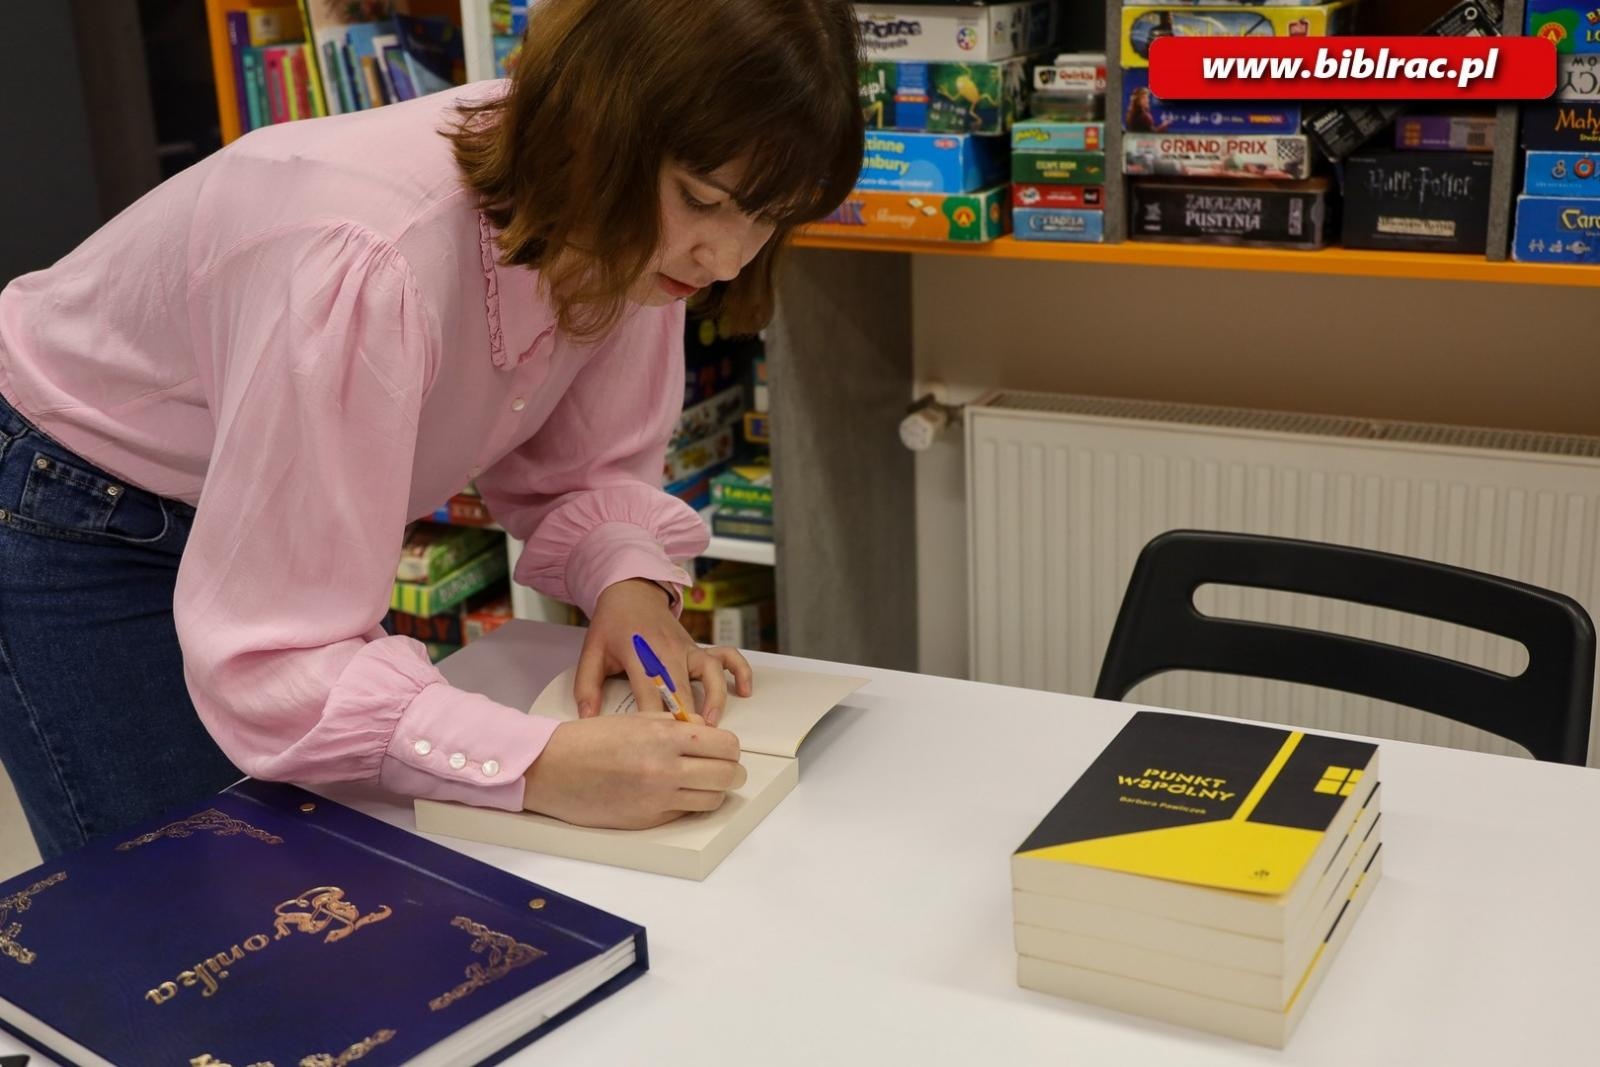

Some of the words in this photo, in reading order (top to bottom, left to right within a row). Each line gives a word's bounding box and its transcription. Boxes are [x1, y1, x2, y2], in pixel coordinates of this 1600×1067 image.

[1160, 139, 1220, 154] GRAND
[1227, 140, 1267, 155] PRIX
[1185, 194, 1262, 213] ZAKAZANA
[1185, 209, 1262, 231] PUSTYNIA
[1143, 768, 1227, 789] PUNKT
[1119, 796, 1158, 807] Barbara
[145, 886, 392, 1005] Kronika
